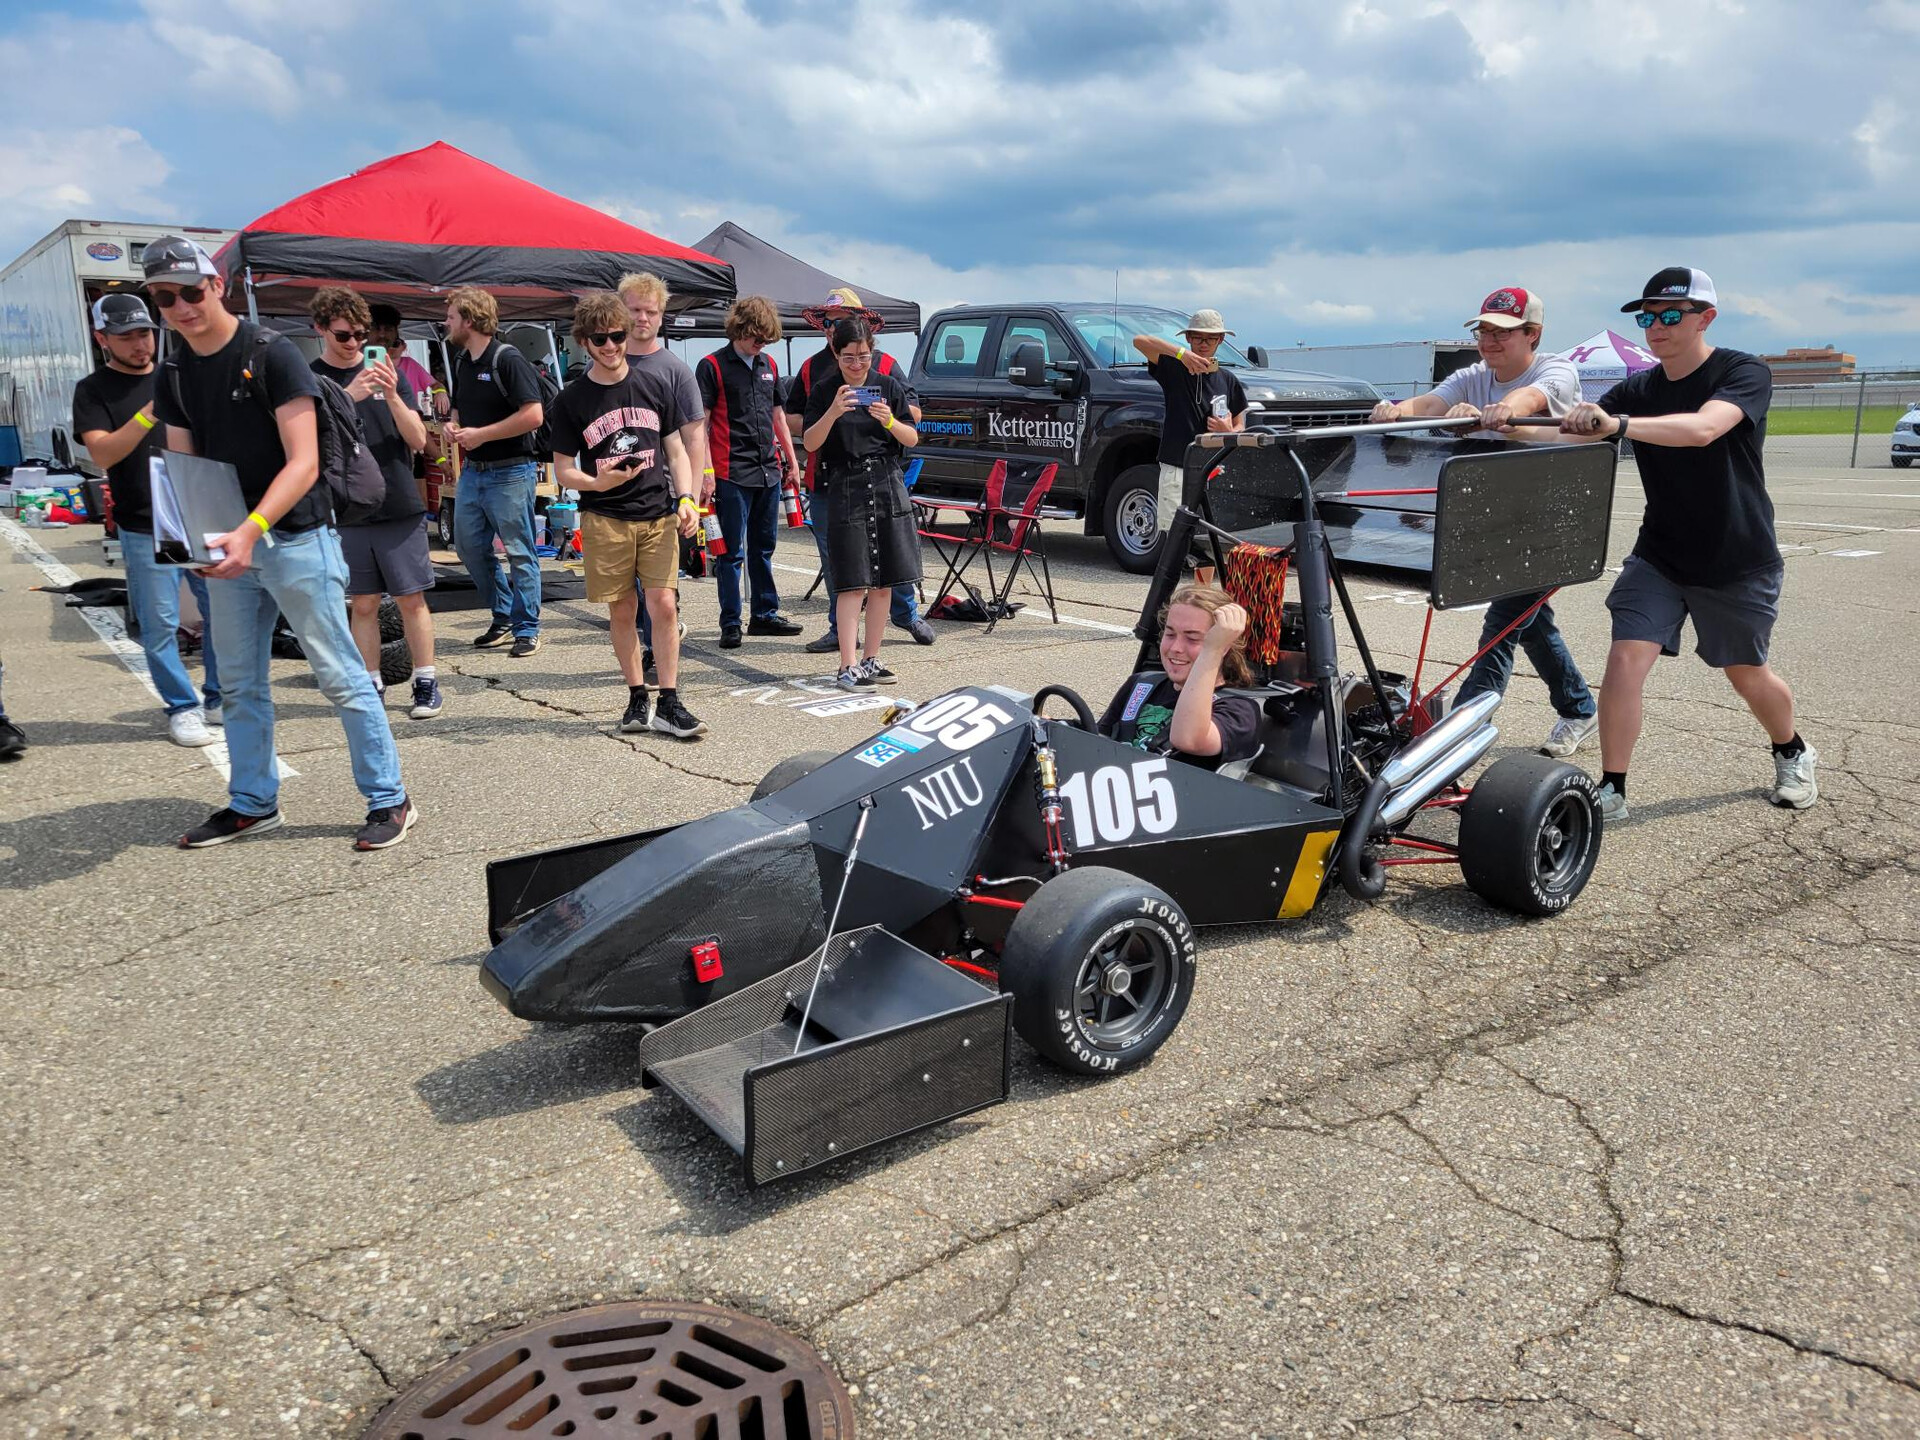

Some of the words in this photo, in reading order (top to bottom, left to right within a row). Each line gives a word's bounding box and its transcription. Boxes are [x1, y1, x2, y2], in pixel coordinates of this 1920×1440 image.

[915, 421, 973, 436] MOTORSPORTS
[988, 412, 1075, 449] Kettering
[1027, 438, 1065, 448] UNIVERSITY
[816, 702, 851, 714] PIT
[864, 743, 900, 763] SAE
[901, 756, 984, 831] NIU
[1059, 758, 1178, 848] 105
[1143, 1014, 1164, 1037] RACING
